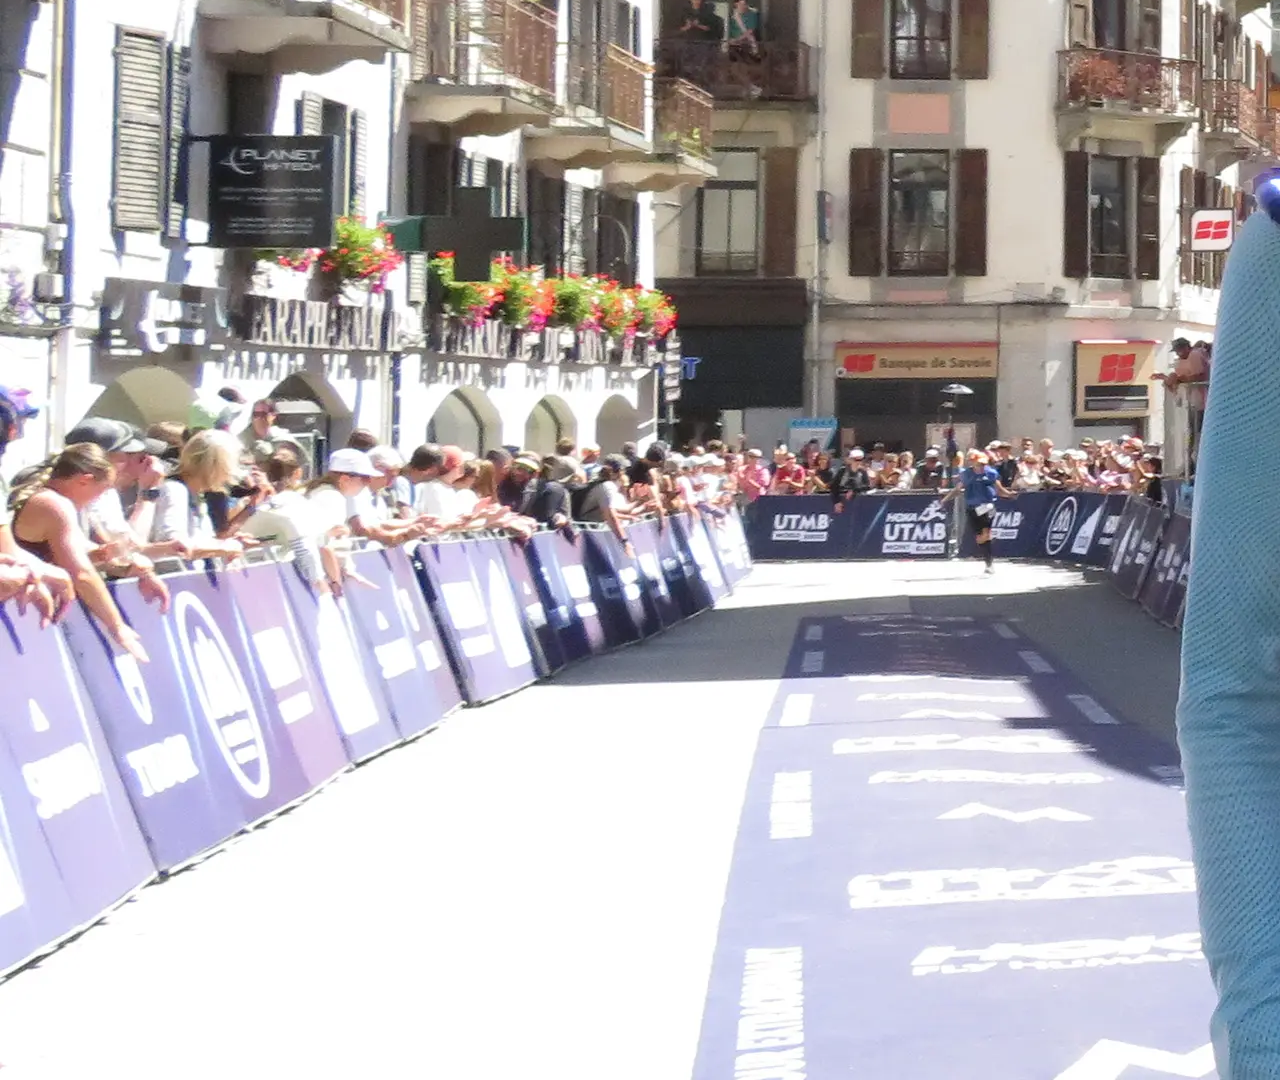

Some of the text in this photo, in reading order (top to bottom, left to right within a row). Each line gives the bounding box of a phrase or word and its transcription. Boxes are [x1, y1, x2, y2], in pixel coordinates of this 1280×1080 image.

[240, 148, 321, 160] PLANET
[879, 357, 992, 370] Banque de Savoie
[773, 514, 830, 530] UTMB
[991, 512, 1022, 528] TMB
[883, 523, 947, 541] UTMB
[911, 932, 1203, 966] HOK
